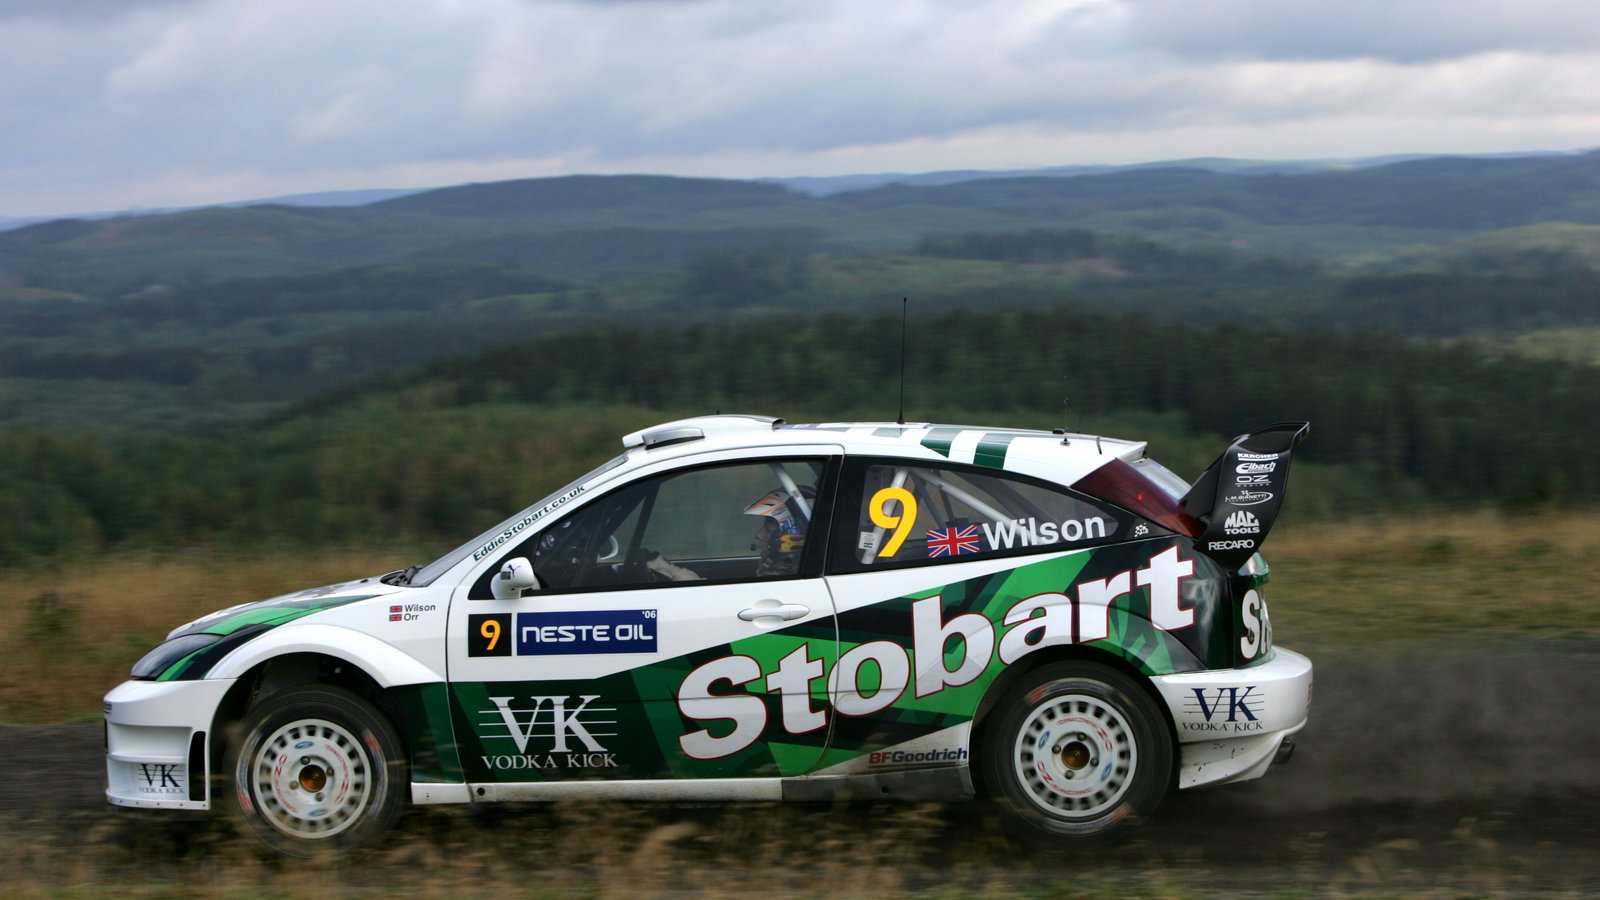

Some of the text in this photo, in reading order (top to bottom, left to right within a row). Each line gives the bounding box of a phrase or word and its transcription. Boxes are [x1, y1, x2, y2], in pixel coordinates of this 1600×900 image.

[473, 485, 585, 561] EddieStobart.co.uk
[868, 487, 918, 557] 9
[1224, 510, 1260, 528] MAC
[982, 516, 1106, 550] Wilson
[1224, 526, 1260, 535] TOOLS
[1208, 539, 1255, 550] RECARO
[403, 613, 420, 621] Orr
[404, 604, 436, 612] Wilson
[480, 619, 501, 651] 9
[522, 624, 653, 643] NESTE OIL
[678, 544, 1196, 760] Stobart
[1190, 685, 1259, 722] VK
[488, 694, 609, 754] VK
[1182, 720, 1263, 732] VODKA KICK
[481, 753, 619, 770] VODKA KICK
[869, 747, 968, 765] BFGoodrich
[140, 763, 181, 788] VK
